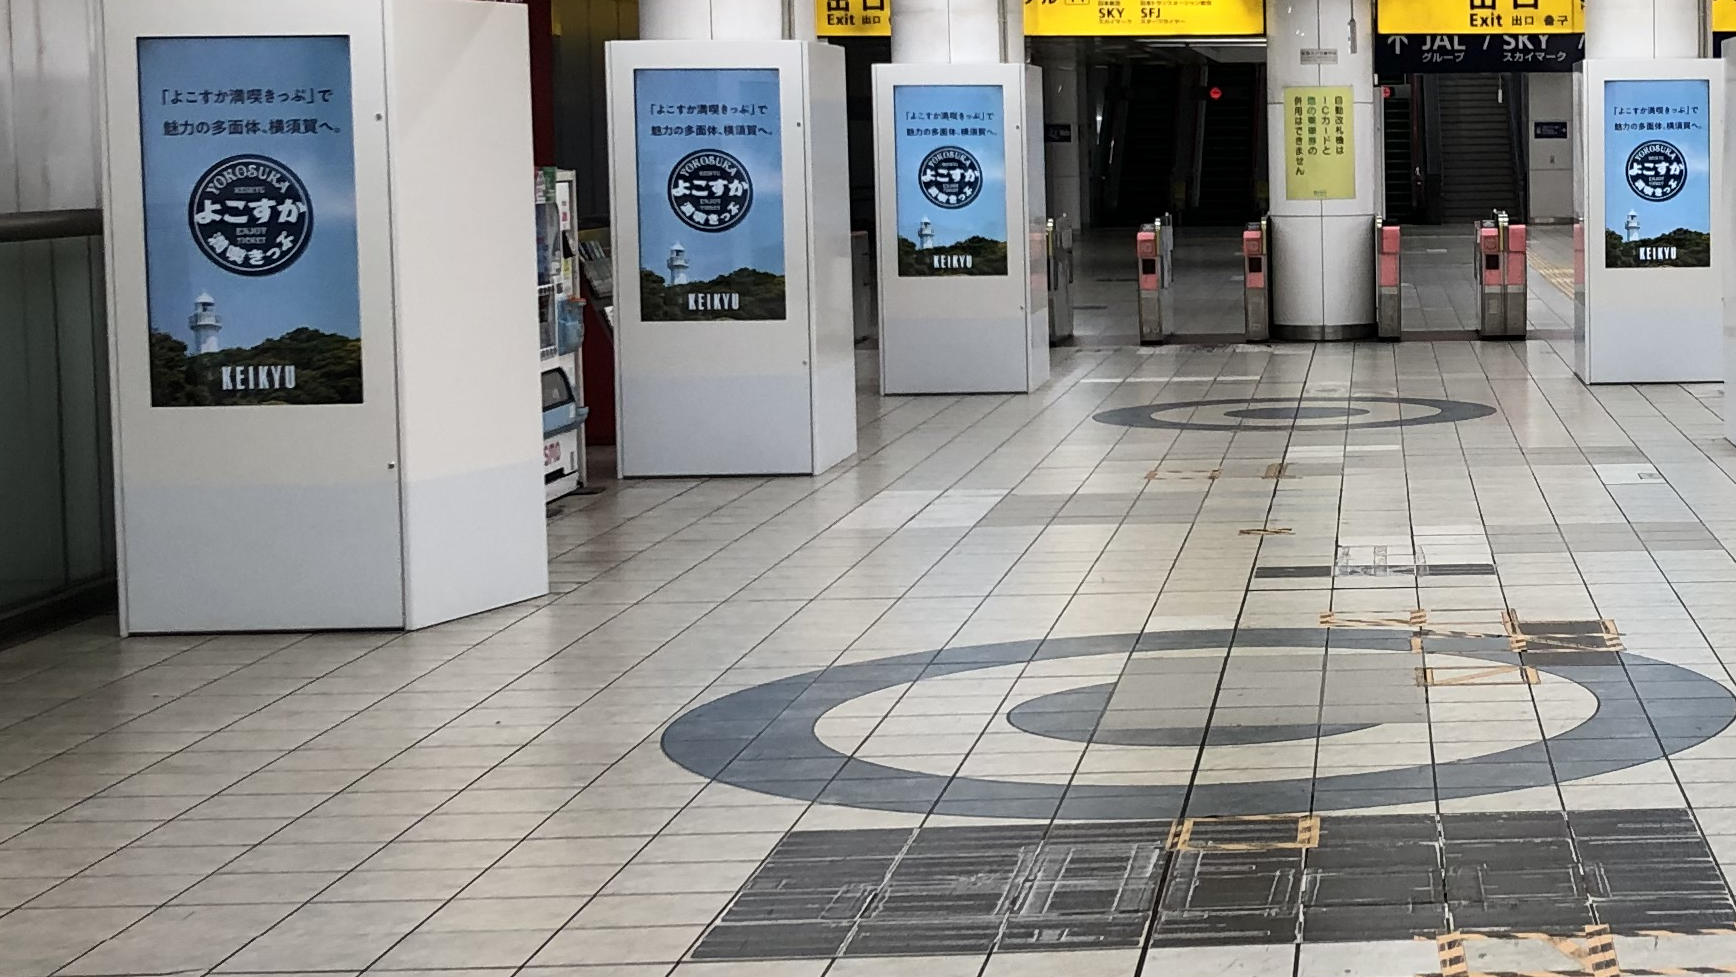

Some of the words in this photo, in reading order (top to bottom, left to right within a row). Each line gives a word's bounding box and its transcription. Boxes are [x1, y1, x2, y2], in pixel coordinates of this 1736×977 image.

[827, 13, 856, 25] Exit
[1099, 7, 1125, 19] SKY
[1141, 7, 1161, 19] SFJ
[1470, 12, 1503, 27] Exit
[1421, 35, 1466, 51] JAL
[1503, 35, 1548, 50] SKY
[1422, 52, 1465, 63] グループ
[1502, 51, 1566, 62] スカイマーク
[1334, 96, 1345, 155] 自動改札機は
[1629, 162, 1684, 175] よこすか
[205, 164, 290, 194] YOKOSUKA
[672, 179, 748, 196] よこすか
[195, 198, 306, 224] よこすか
[1639, 247, 1677, 260] KEIKYU
[933, 255, 973, 269] KEIKYU
[688, 293, 739, 310] KEIKYU
[221, 365, 296, 390] KEIKYU
